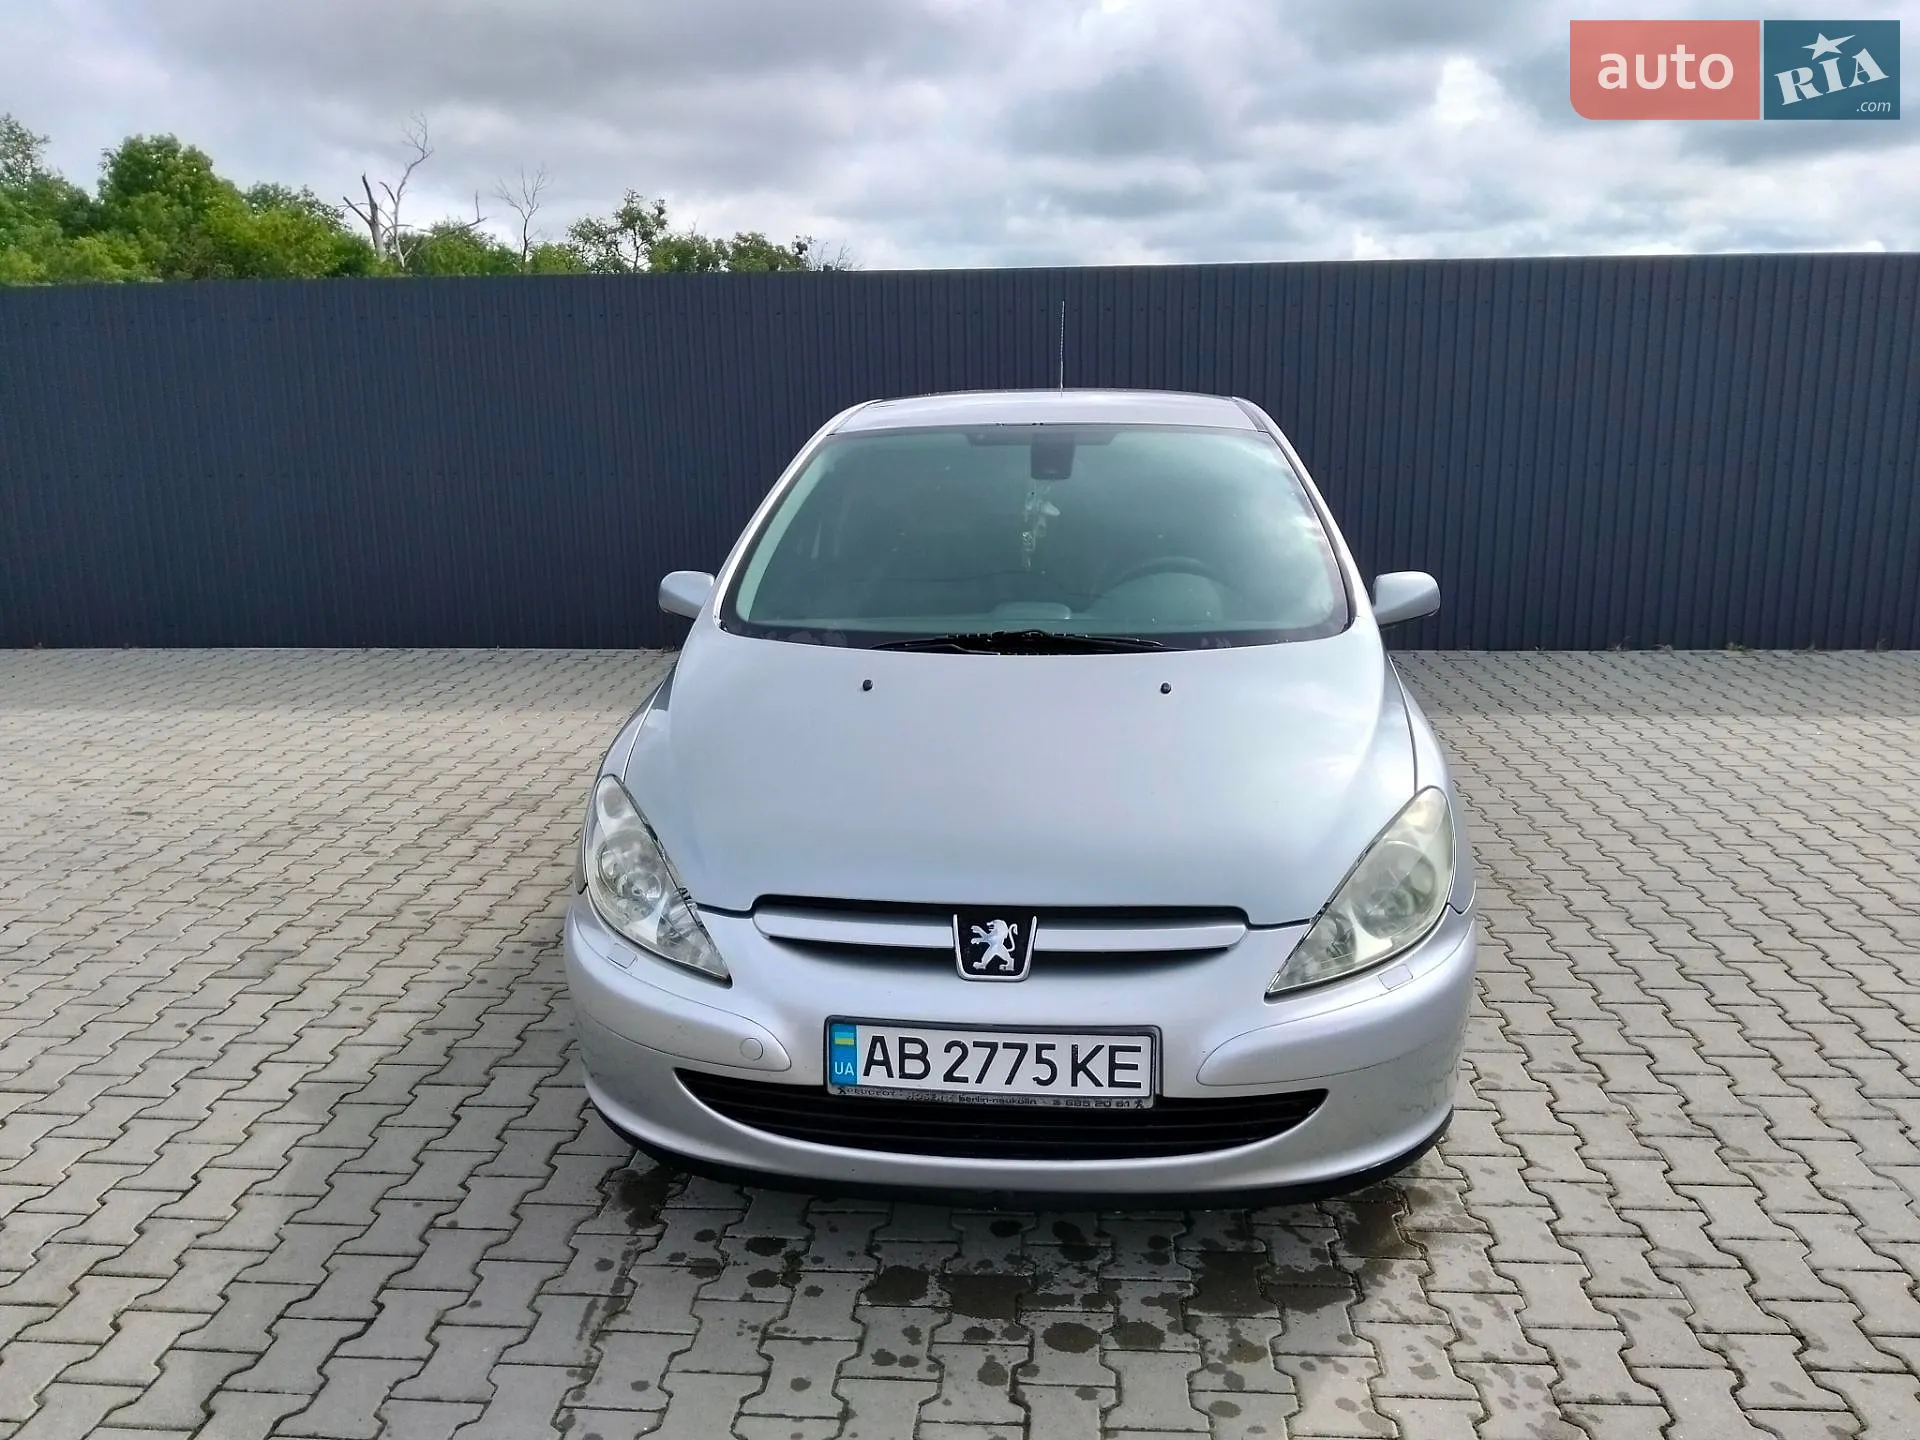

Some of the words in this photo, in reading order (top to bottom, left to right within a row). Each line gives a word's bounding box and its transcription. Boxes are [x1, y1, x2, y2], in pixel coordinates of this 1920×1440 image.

[834, 1061, 855, 1076] UA
[862, 1035, 931, 1081] AB
[942, 1040, 1058, 1086] 2775
[1070, 1044, 1142, 1089] KE
